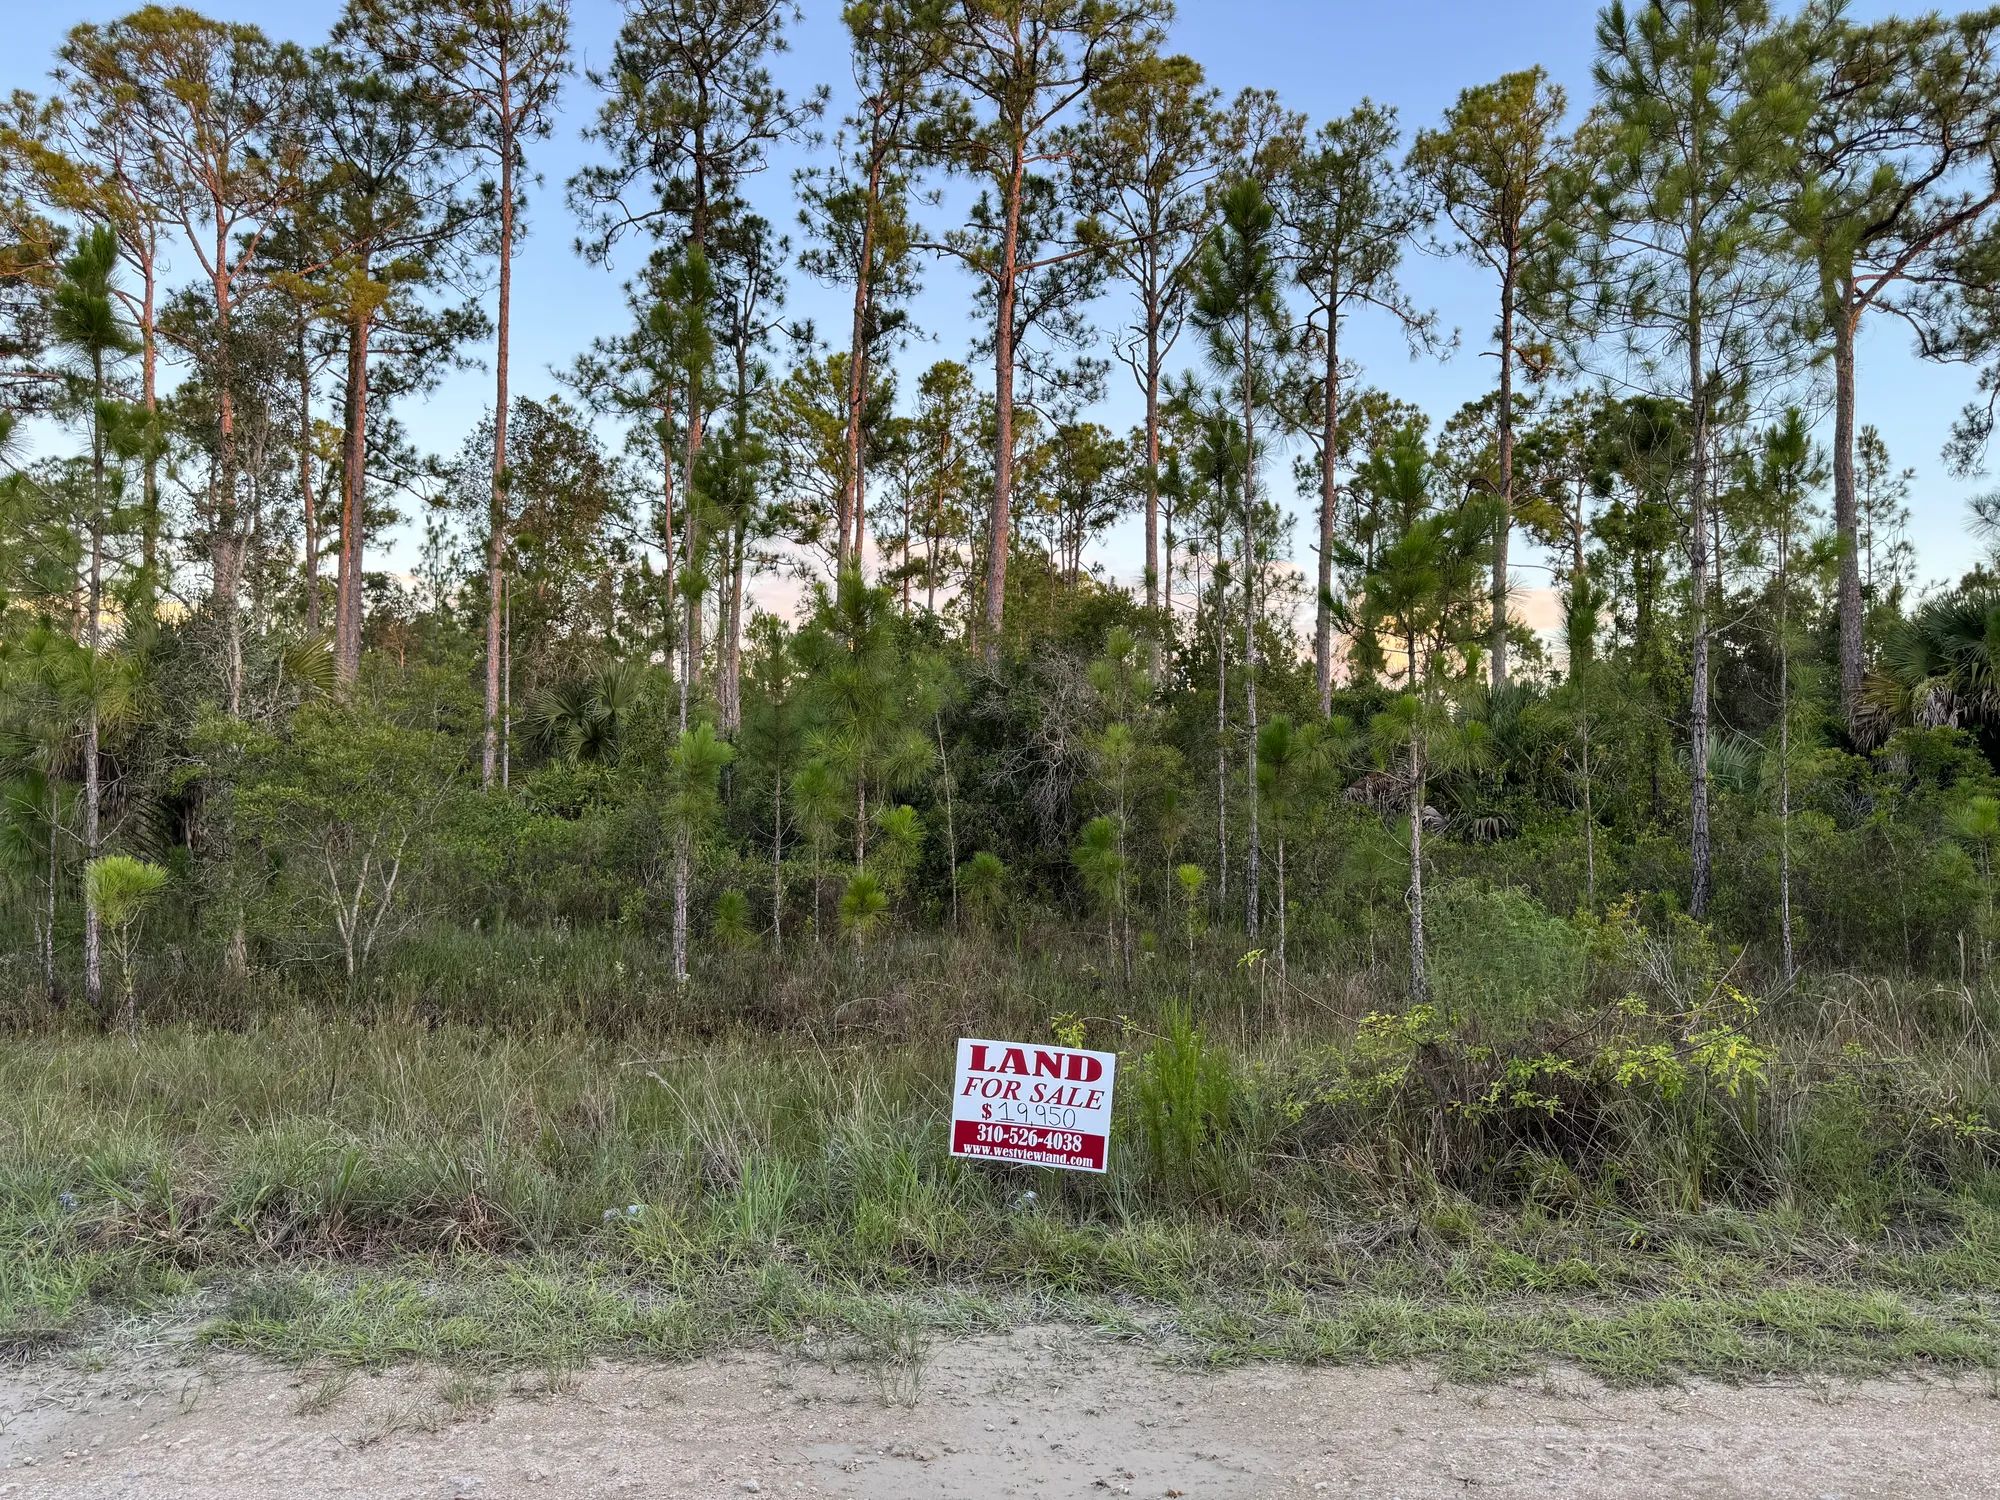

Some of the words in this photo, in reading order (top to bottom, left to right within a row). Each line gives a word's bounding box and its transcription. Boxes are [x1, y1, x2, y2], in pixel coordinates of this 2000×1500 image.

[968, 1045, 1102, 1082] LAND
[960, 1076, 1022, 1100] FOR
[1029, 1082, 1105, 1110] SALE
[976, 1124, 1083, 1152] 310-526-4038
[963, 1143, 1093, 1168] www.westviewland.com
